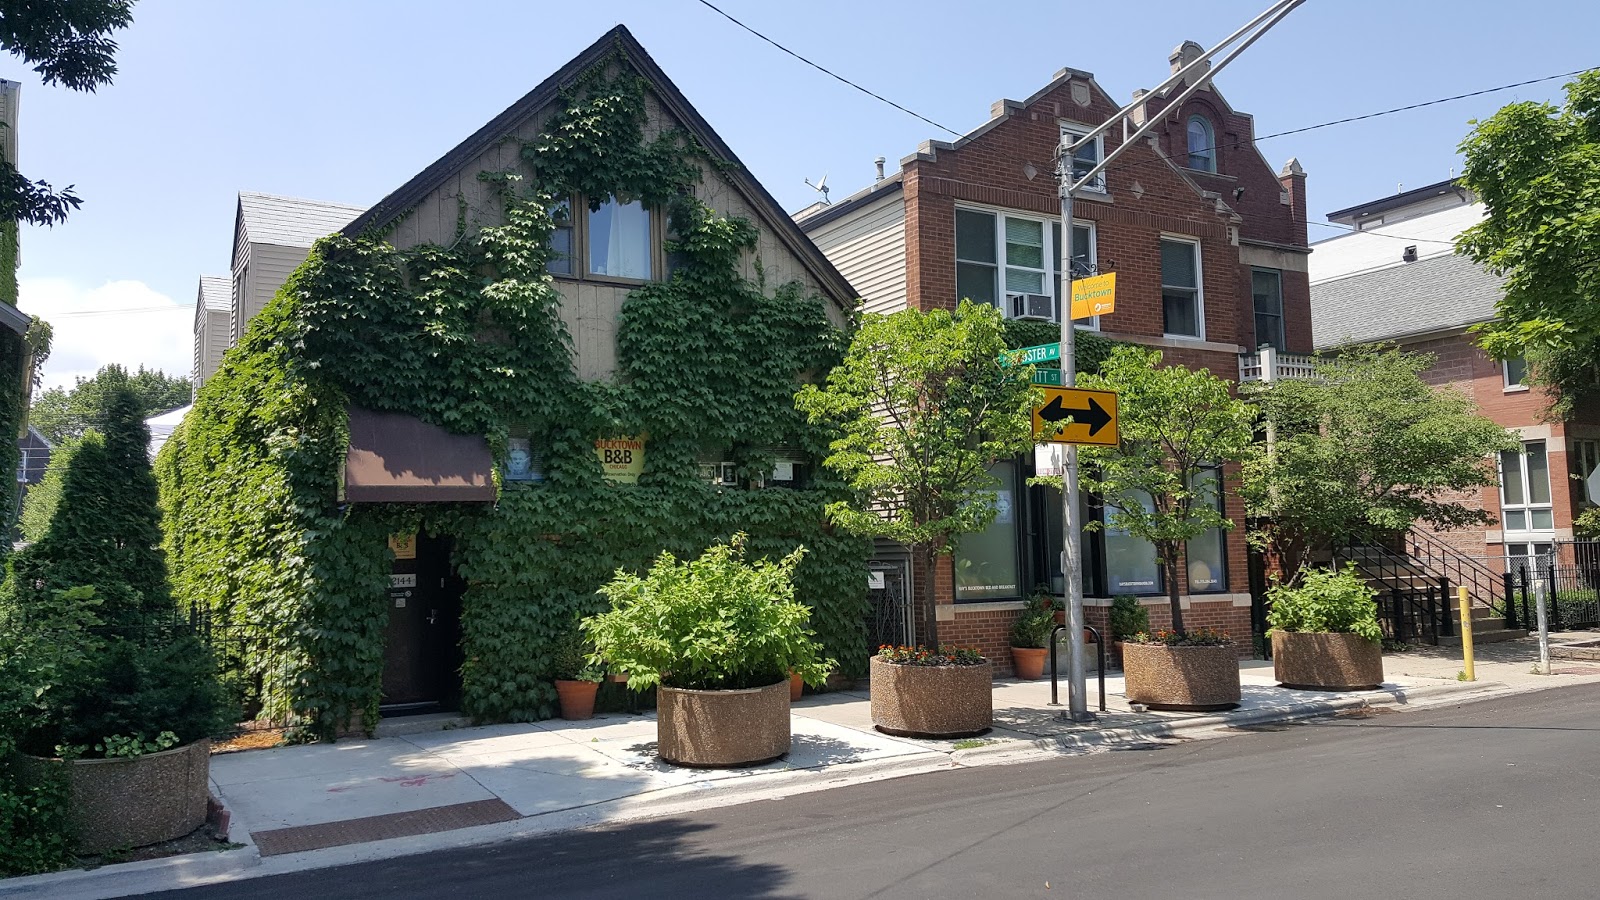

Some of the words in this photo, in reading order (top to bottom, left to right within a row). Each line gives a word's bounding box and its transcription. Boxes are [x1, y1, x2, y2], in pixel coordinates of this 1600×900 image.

[1075, 289, 1111, 301] Bucktown
[1049, 348, 1056, 356] AV
[594, 440, 642, 450] BUCKTOWN
[605, 450, 633, 464] B&B
[392, 577, 411, 585] 2144
